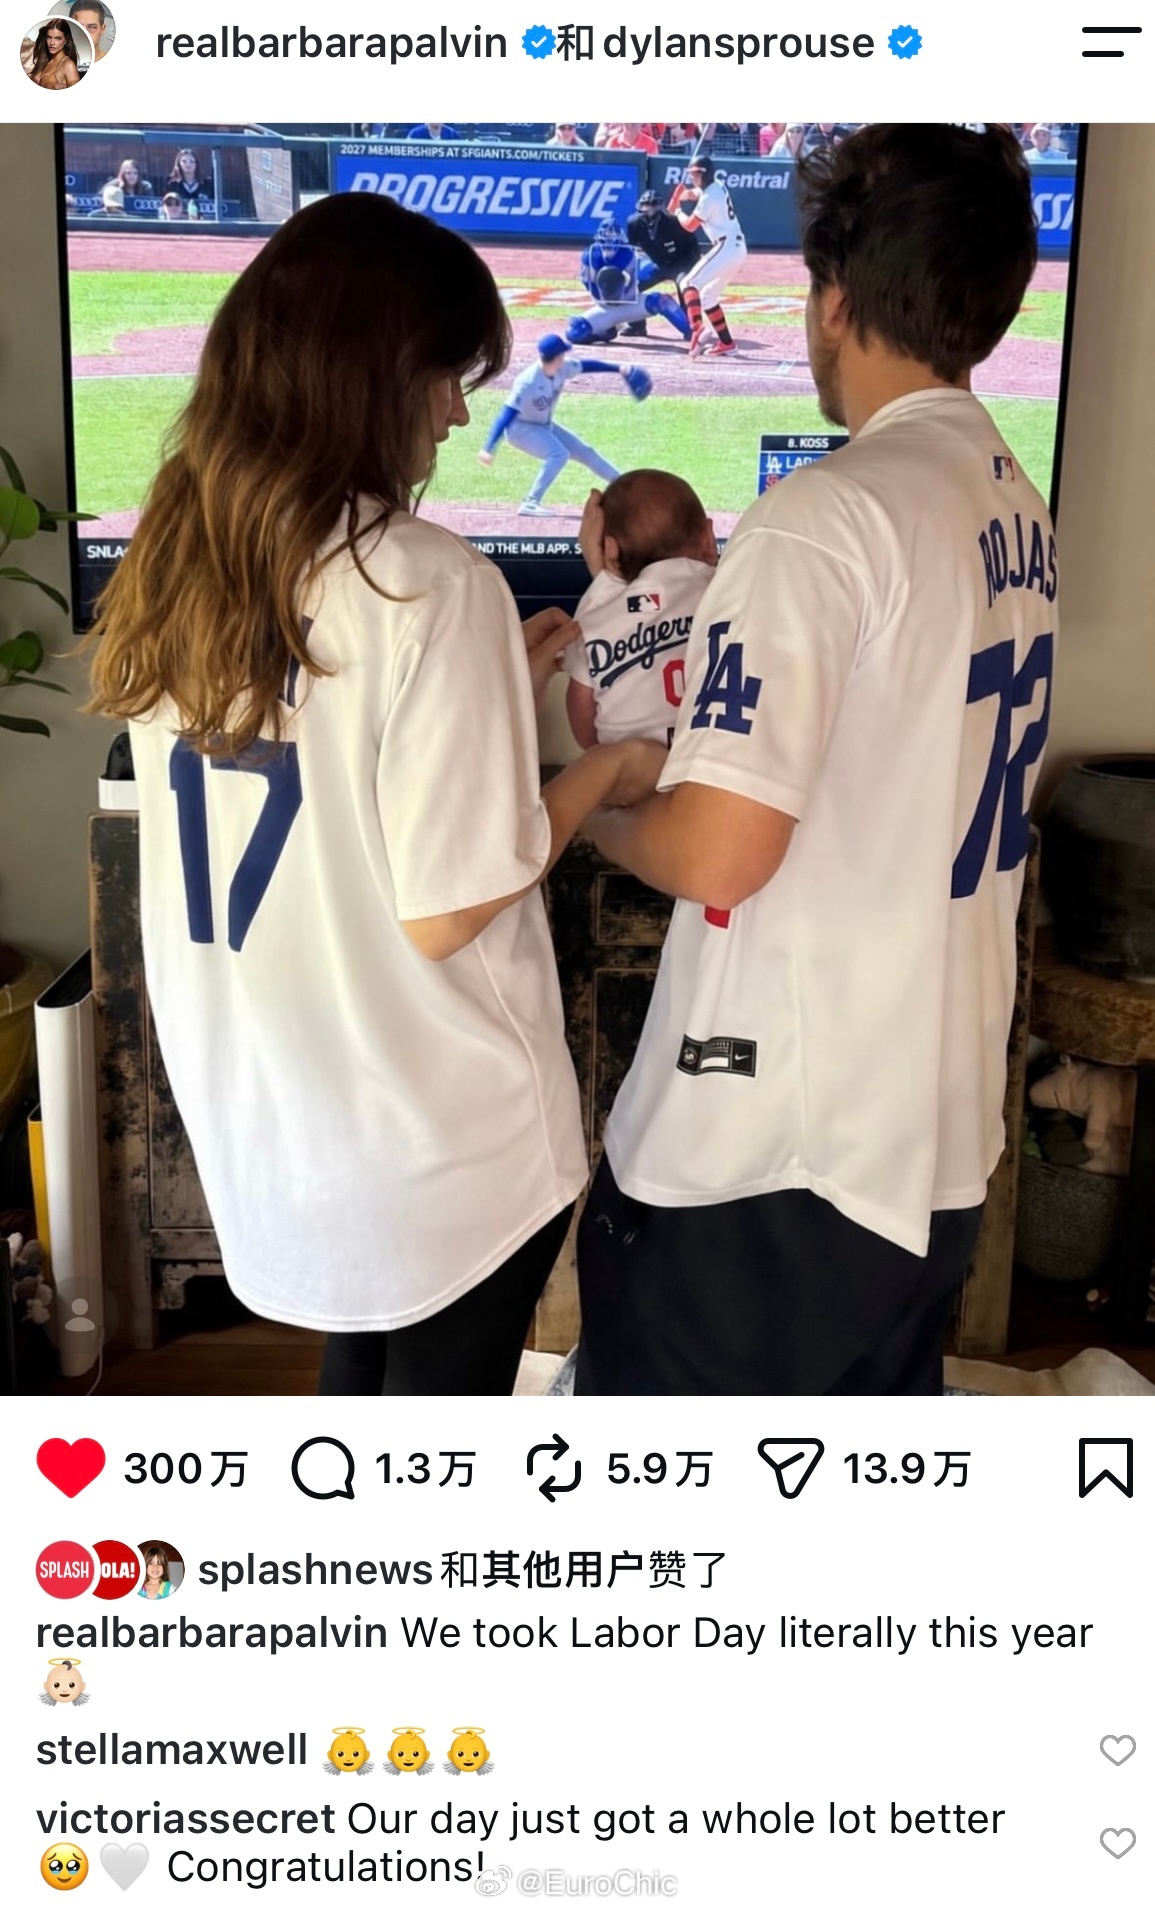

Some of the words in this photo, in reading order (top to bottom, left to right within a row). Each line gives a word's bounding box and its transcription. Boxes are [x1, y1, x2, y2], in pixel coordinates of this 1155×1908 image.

[340, 144, 366, 155] 2027
[368, 145, 445, 158] MEMBERSHIPS
[446, 147, 459, 158] AT
[462, 147, 585, 163] SFGIANTS.COM/TICKETS
[350, 172, 625, 218] PROGRESSIVE
[800, 437, 830, 448] KOSS
[473, 542, 495, 554] ND
[496, 543, 519, 554] THE
[521, 543, 544, 554] MLB
[546, 543, 573, 555] APP.
[978, 512, 1058, 610] ROJAS
[690, 620, 763, 736] LA
[950, 631, 1054, 900] 72
[169, 733, 303, 953] 17
